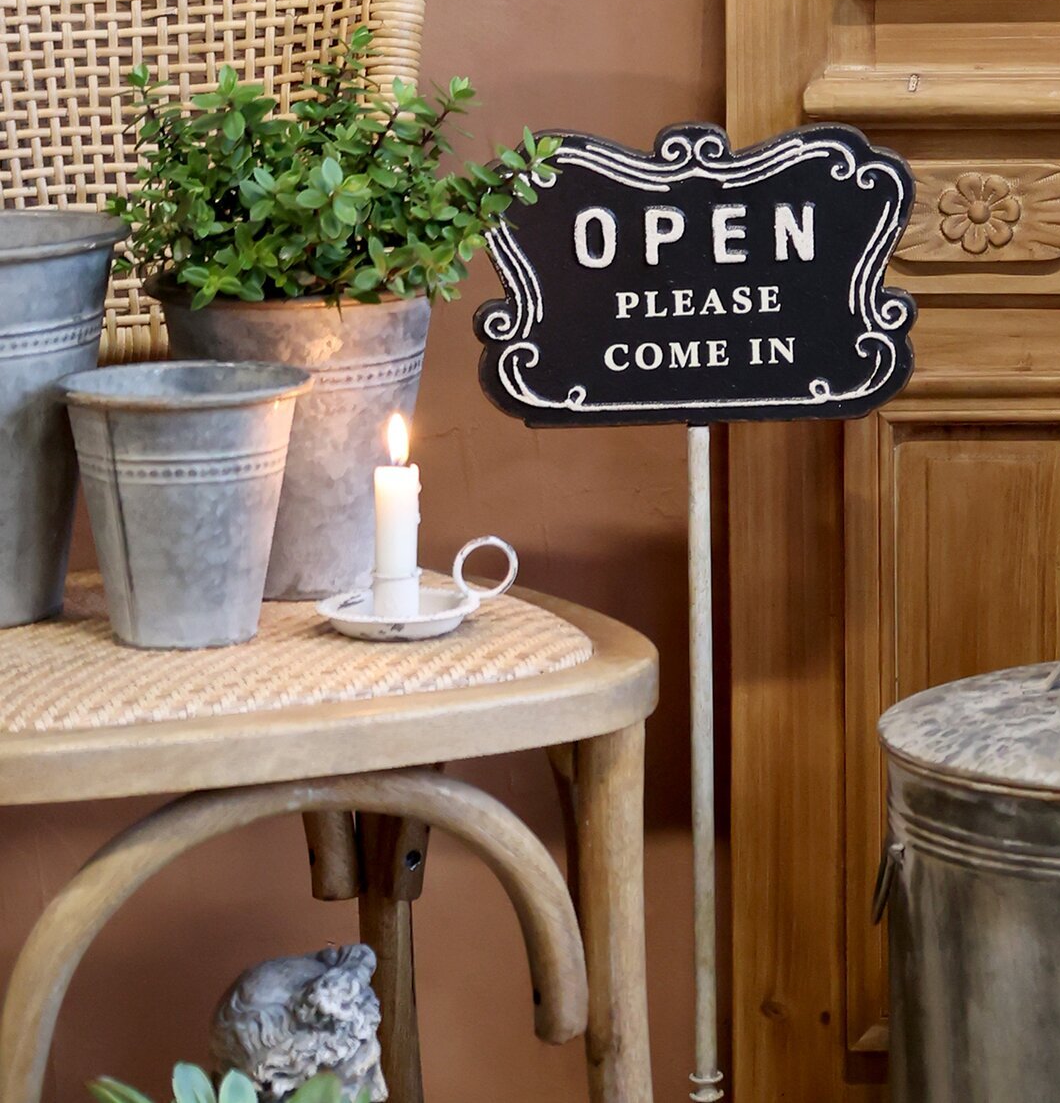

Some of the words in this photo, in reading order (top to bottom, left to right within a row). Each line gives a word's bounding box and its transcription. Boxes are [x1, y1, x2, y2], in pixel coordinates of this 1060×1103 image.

[573, 202, 815, 269] OPEN
[615, 285, 782, 319] PLEASE
[603, 339, 730, 372] COME
[748, 337, 796, 365] IN
